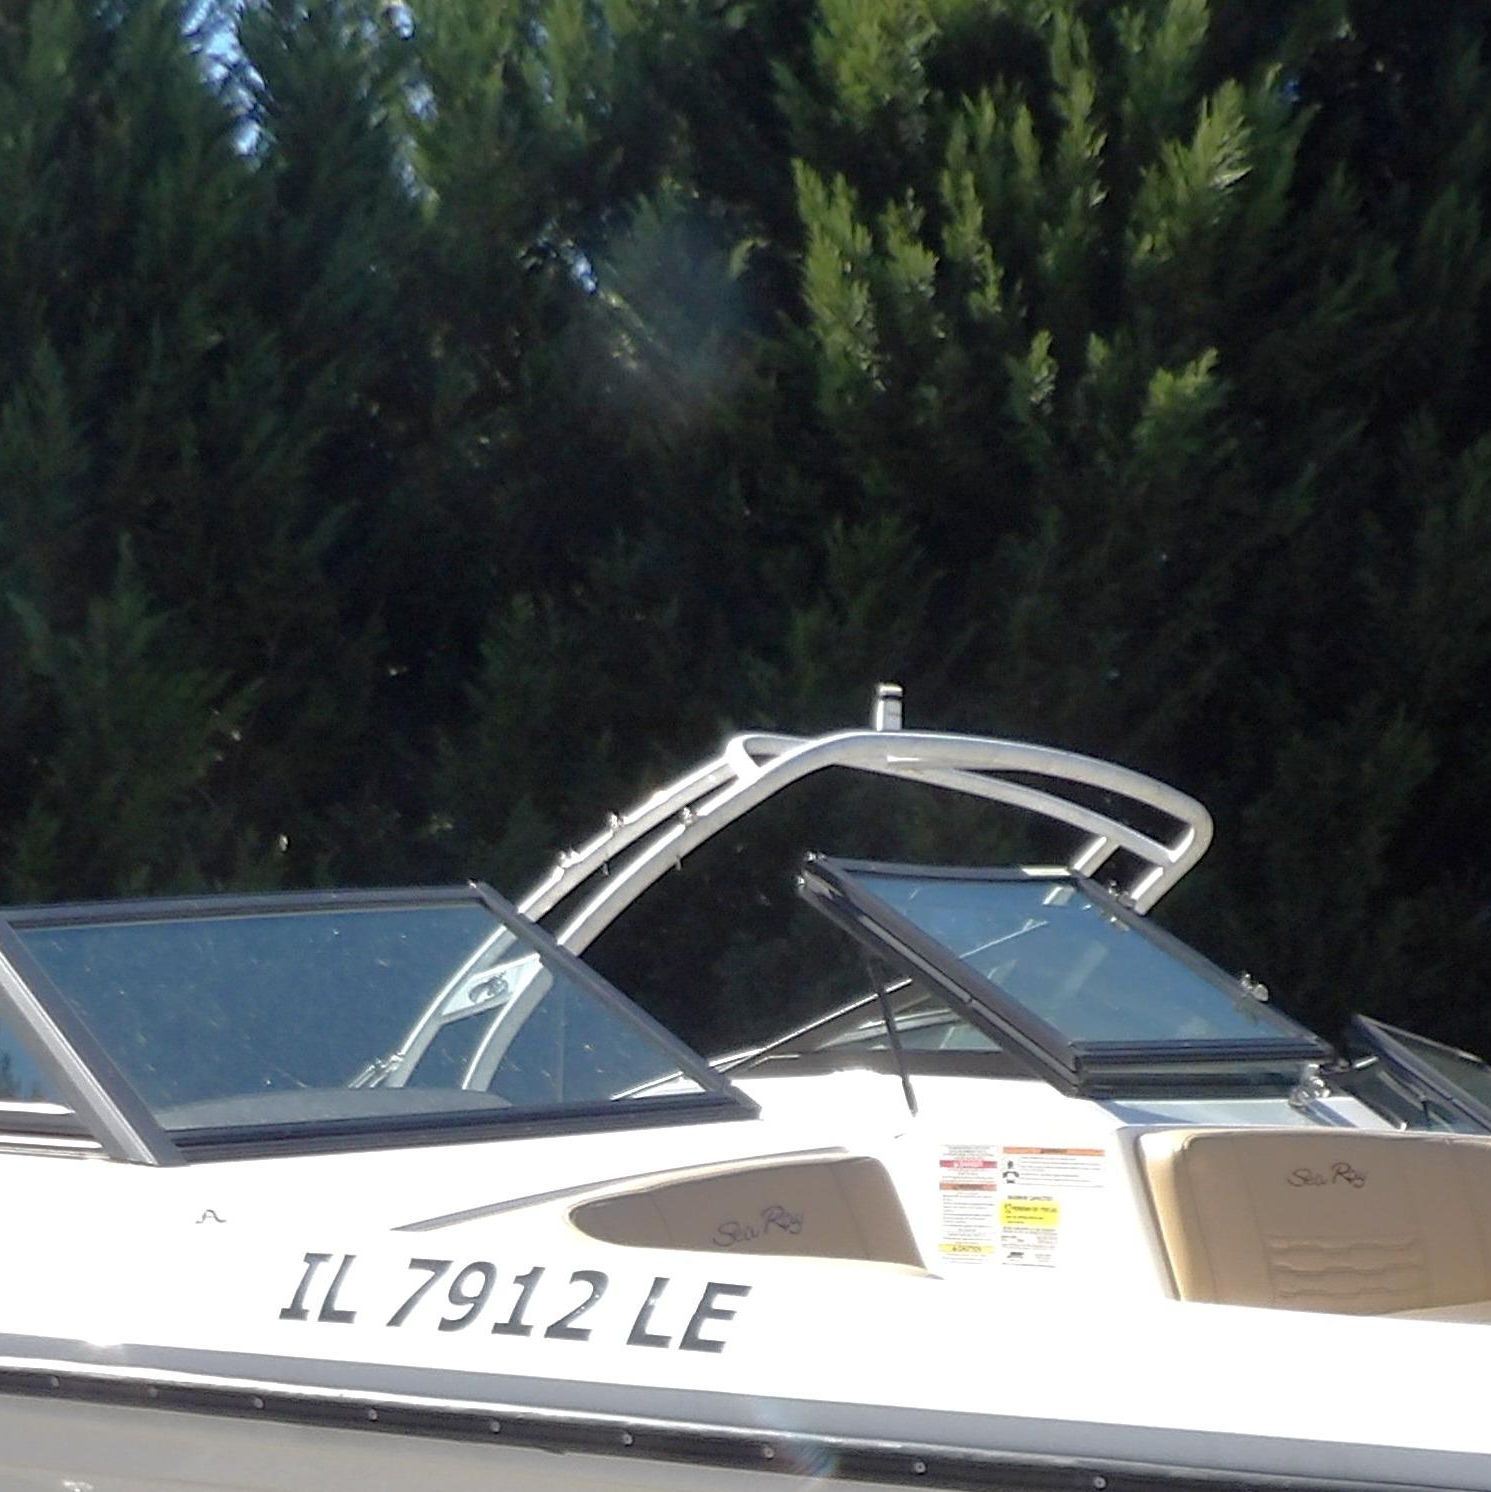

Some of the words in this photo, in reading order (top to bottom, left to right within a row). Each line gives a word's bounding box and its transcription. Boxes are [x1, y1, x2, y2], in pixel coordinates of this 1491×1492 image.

[1288, 1167, 1327, 1188] Sea
[712, 1220, 761, 1247] Sea
[279, 1252, 357, 1324] IL
[386, 1257, 609, 1342] 7912
[626, 1276, 754, 1354] LE
